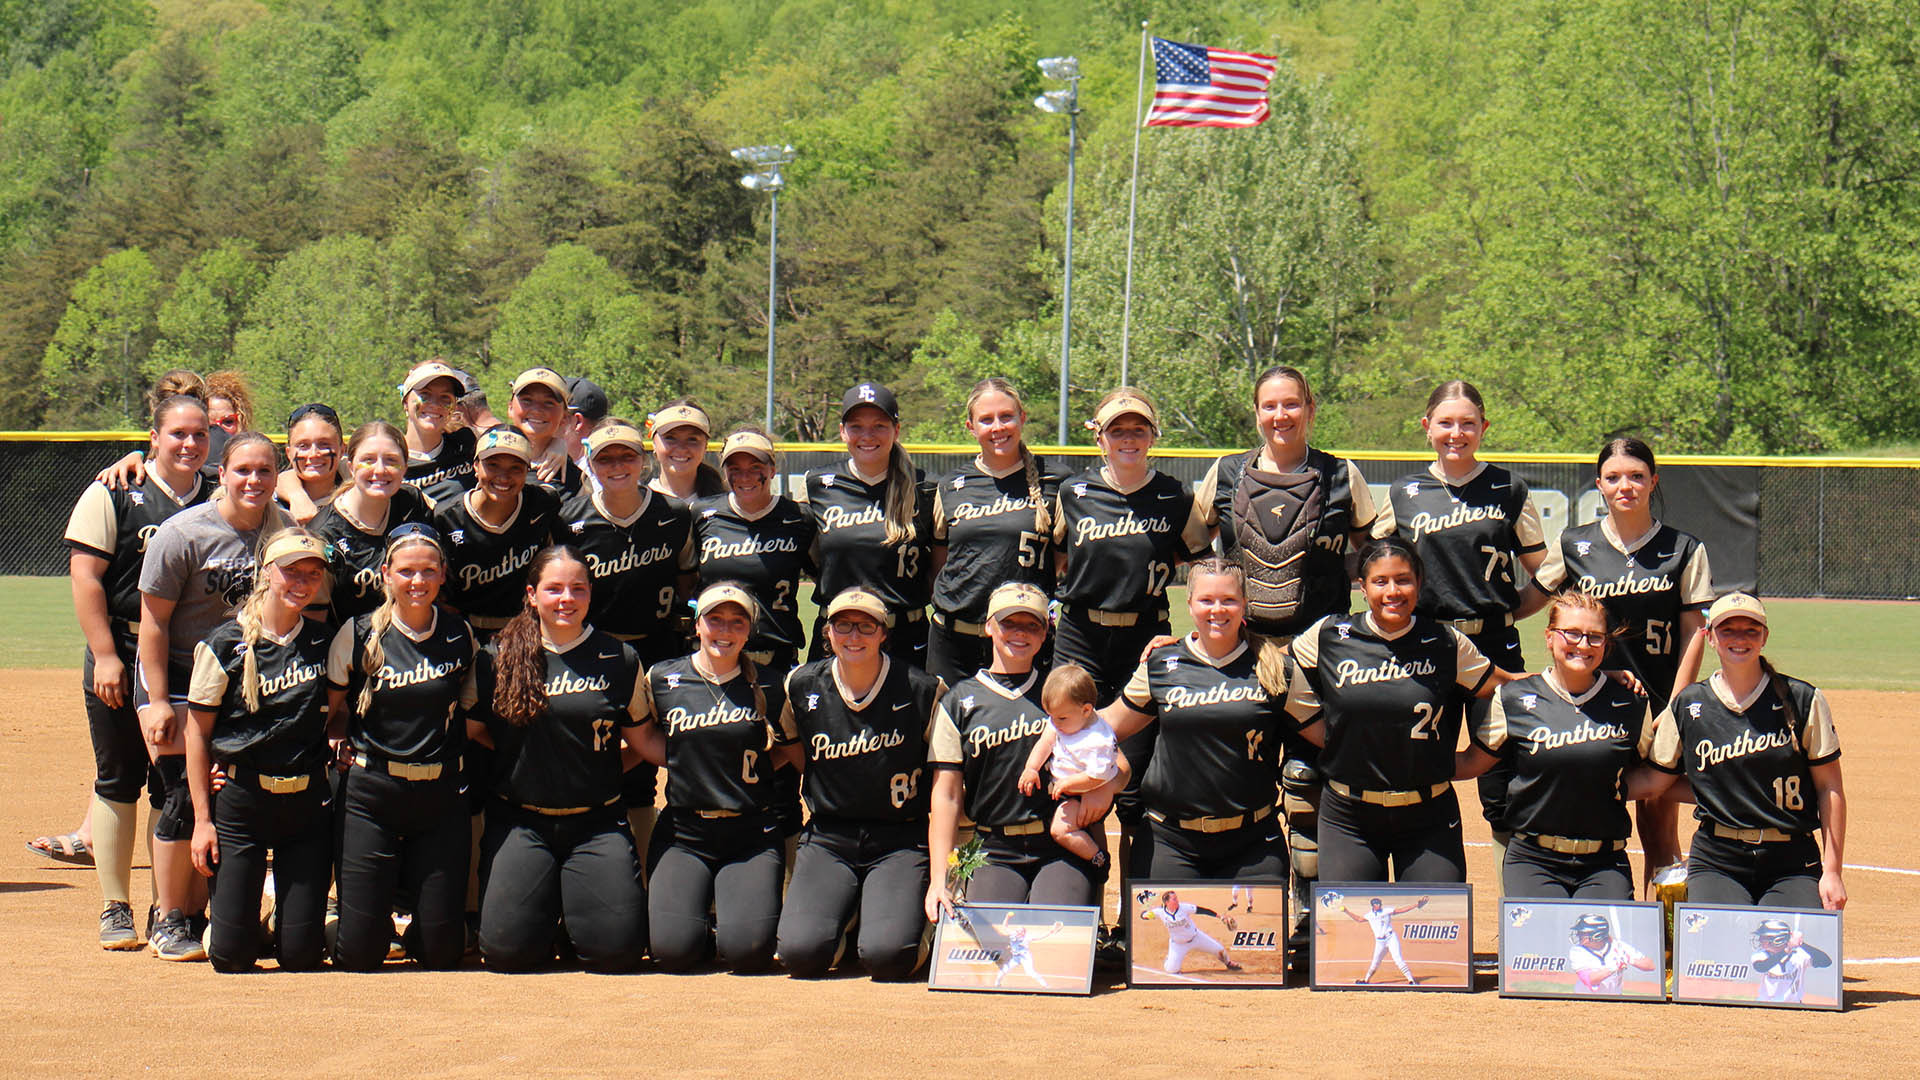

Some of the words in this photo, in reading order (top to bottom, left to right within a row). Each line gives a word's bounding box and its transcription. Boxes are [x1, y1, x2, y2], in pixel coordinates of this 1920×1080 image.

[858, 384, 876, 403] FC
[1074, 511, 1172, 547] Panthers
[1410, 497, 1506, 543] Panthers
[700, 532, 798, 565] Panthers
[895, 544, 918, 578] 13
[1018, 529, 1050, 570] 57
[460, 543, 539, 592] Panther
[1146, 560, 1169, 597] 12
[772, 580, 792, 612] 2
[1576, 570, 1674, 600] Panthers
[656, 586, 675, 619] 9
[1645, 619, 1673, 655] 51
[1336, 655, 1436, 688] Panthers
[1164, 682, 1268, 712] Panthers
[969, 713, 1051, 758] Panther
[1527, 718, 1629, 756] Panthers
[1695, 728, 1791, 773] Panthers
[1772, 775, 1805, 811] 18
[1233, 931, 1276, 946] BELL
[1402, 924, 1460, 940] THOMAS
[1512, 956, 1567, 971] HOPPER
[1687, 963, 1749, 979] HOGSTON
